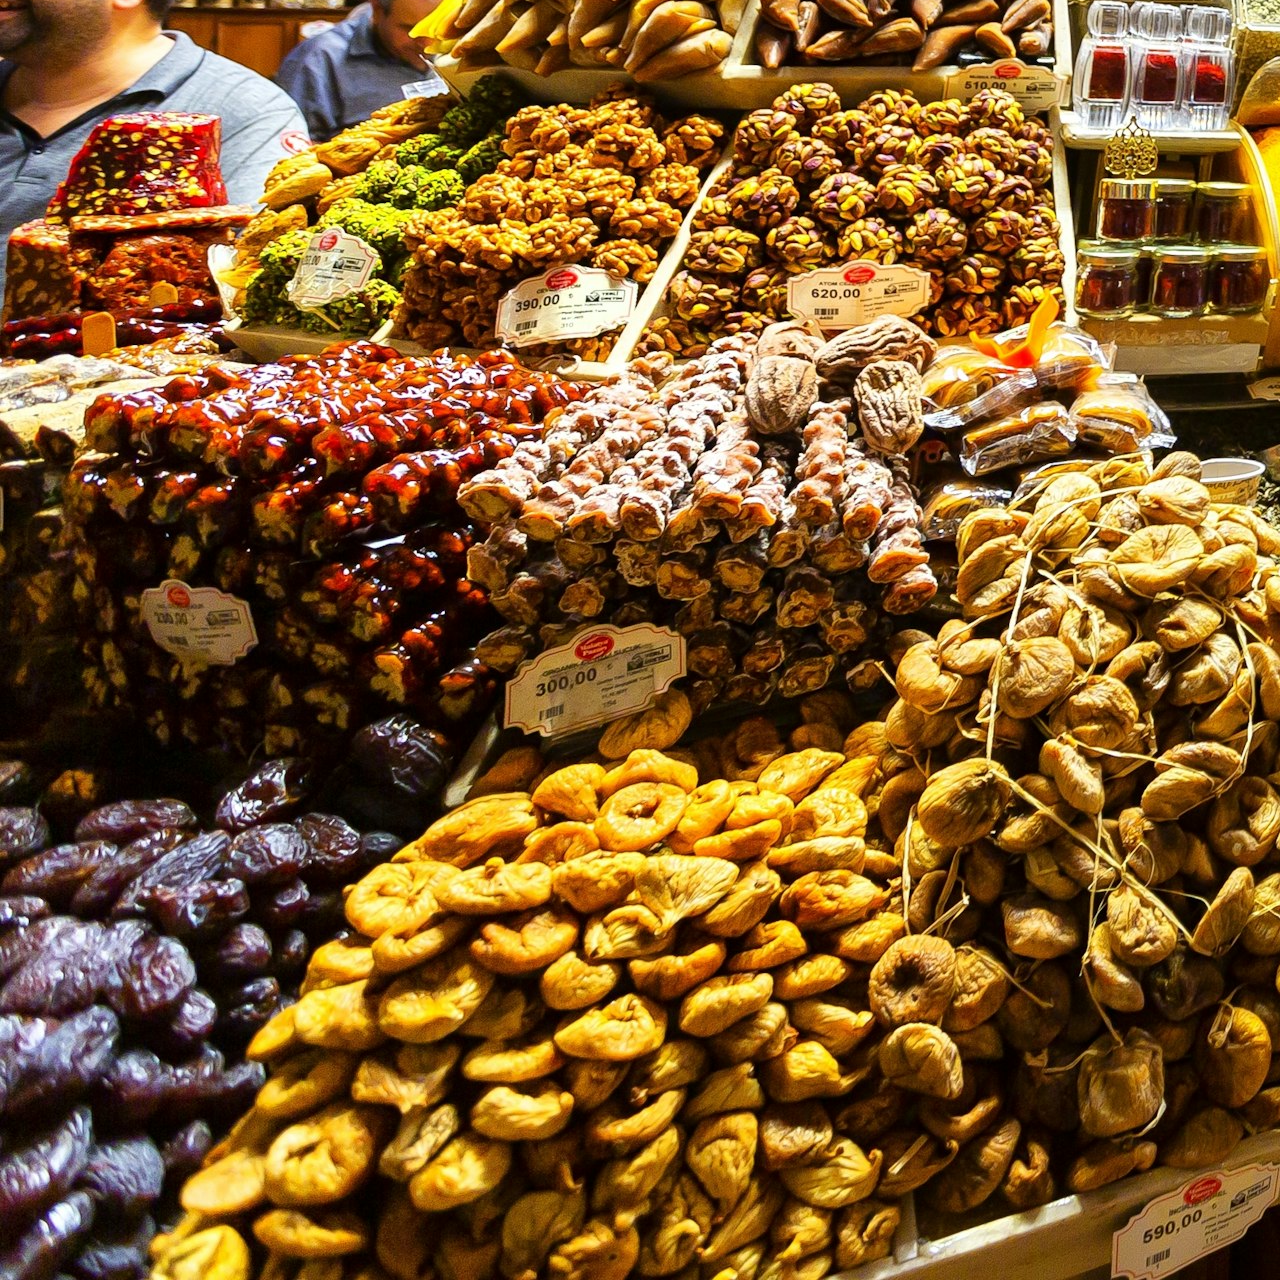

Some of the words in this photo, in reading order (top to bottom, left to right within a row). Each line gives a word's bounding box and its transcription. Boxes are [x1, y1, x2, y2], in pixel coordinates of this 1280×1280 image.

[964, 80, 1007, 91] 510,00
[514, 293, 560, 313] 390,00
[810, 287, 861, 300] 620,00
[534, 668, 598, 697] 300,00
[1142, 1208, 1204, 1244] 590,00
